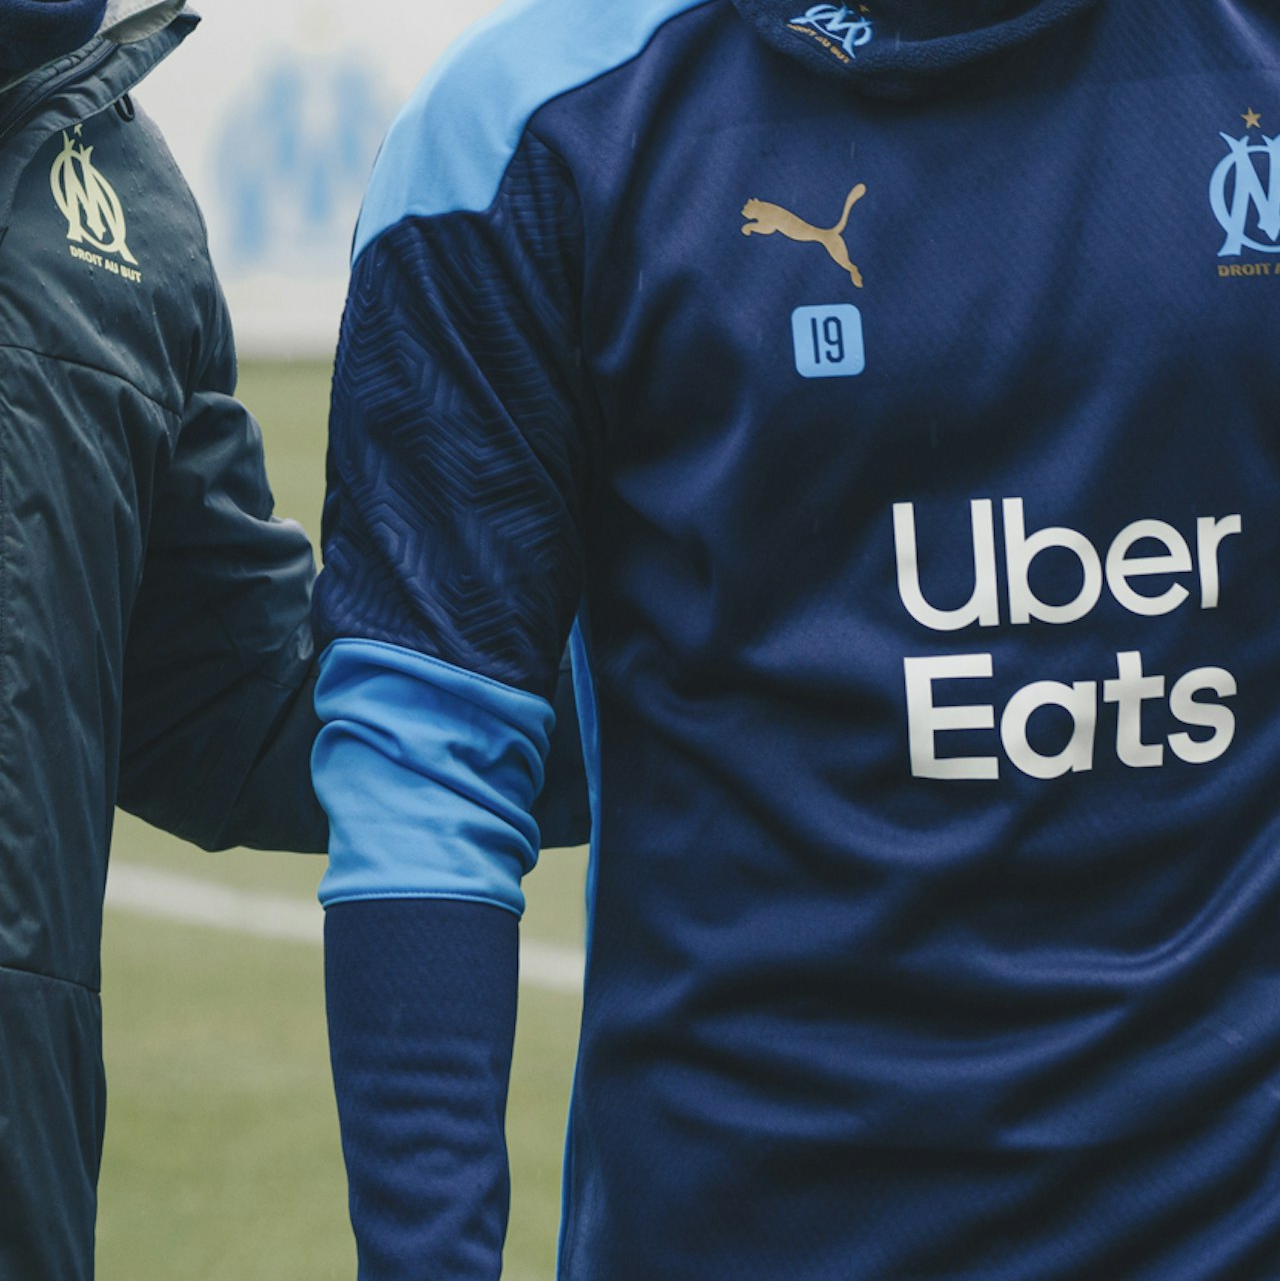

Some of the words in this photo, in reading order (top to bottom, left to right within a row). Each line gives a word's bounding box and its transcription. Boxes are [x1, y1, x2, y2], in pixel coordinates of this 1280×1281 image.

[69, 245, 103, 267] DROIT
[120, 265, 141, 283] BUT
[1217, 263, 1271, 277] DROIT
[810, 316, 845, 364] 19
[892, 496, 1242, 631] Uber
[903, 650, 1238, 780] Eats
